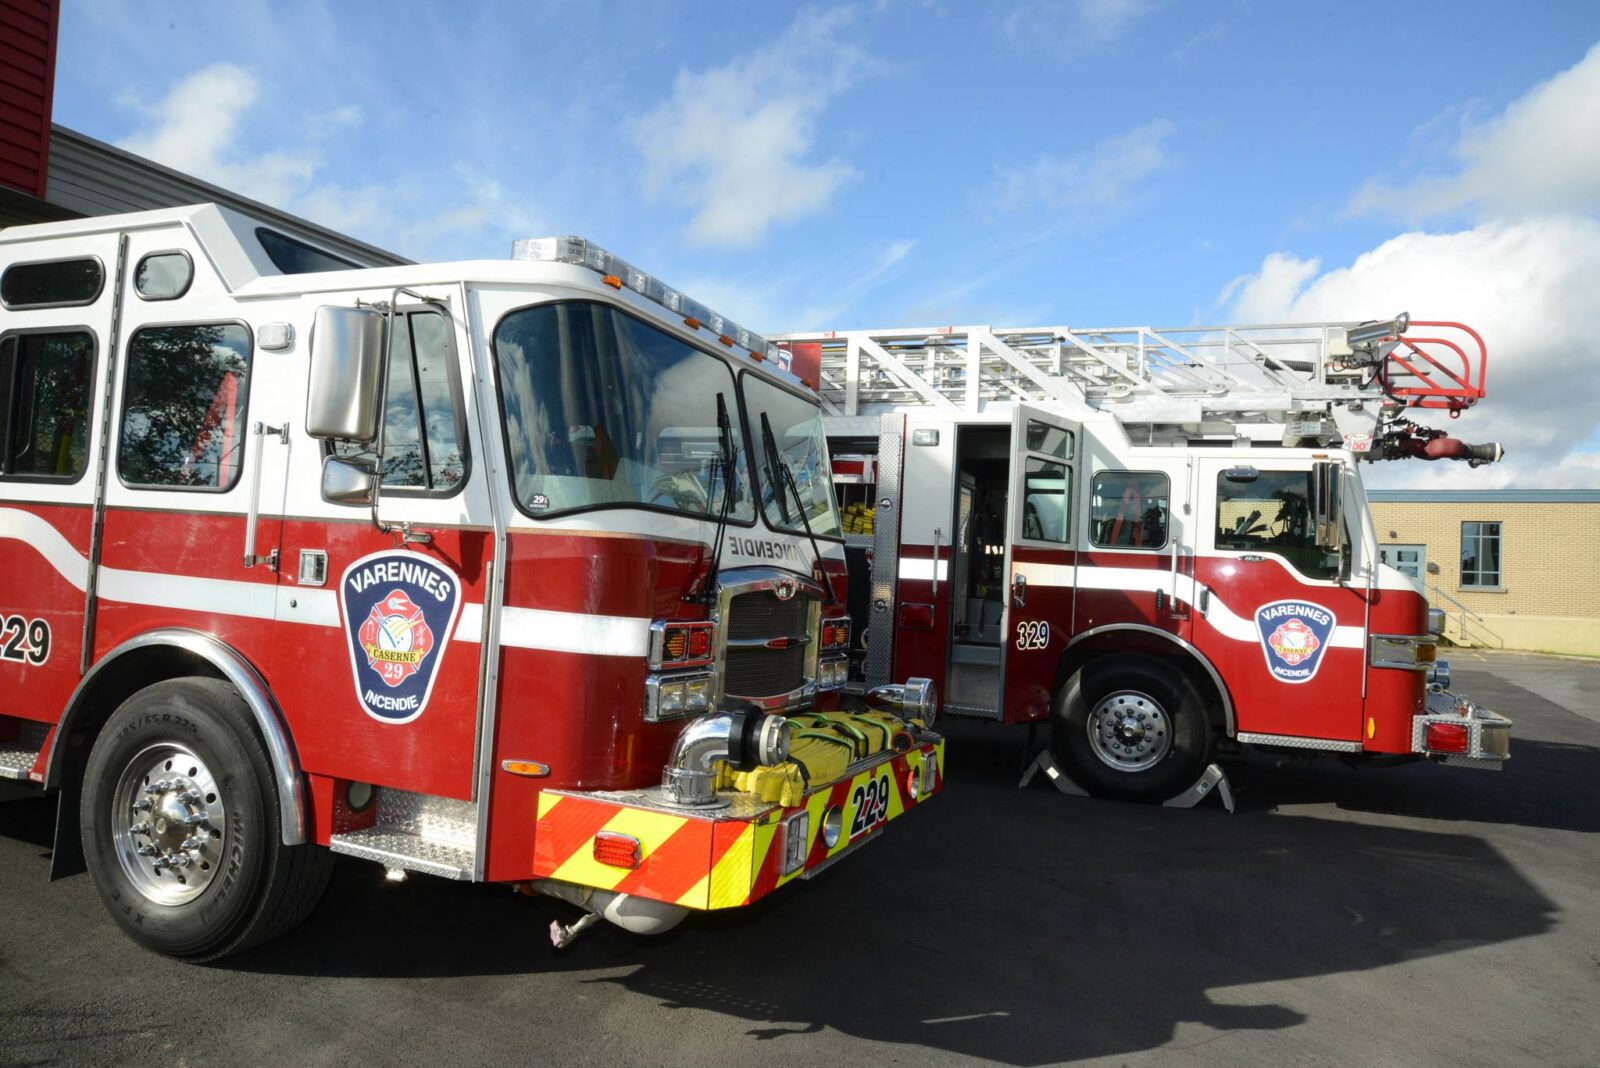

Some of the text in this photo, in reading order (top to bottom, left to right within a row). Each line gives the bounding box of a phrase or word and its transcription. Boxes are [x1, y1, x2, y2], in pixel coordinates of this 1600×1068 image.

[349, 562, 450, 602] VARENNES
[1261, 605, 1330, 626] VARENNES
[0, 614, 51, 666] 29
[1016, 621, 1049, 650] 329
[373, 649, 417, 662] CASERNE
[384, 663, 404, 679] 29
[1274, 666, 1311, 677] INCENDIE
[365, 689, 419, 711] INCENDIE
[850, 773, 889, 838] 229
